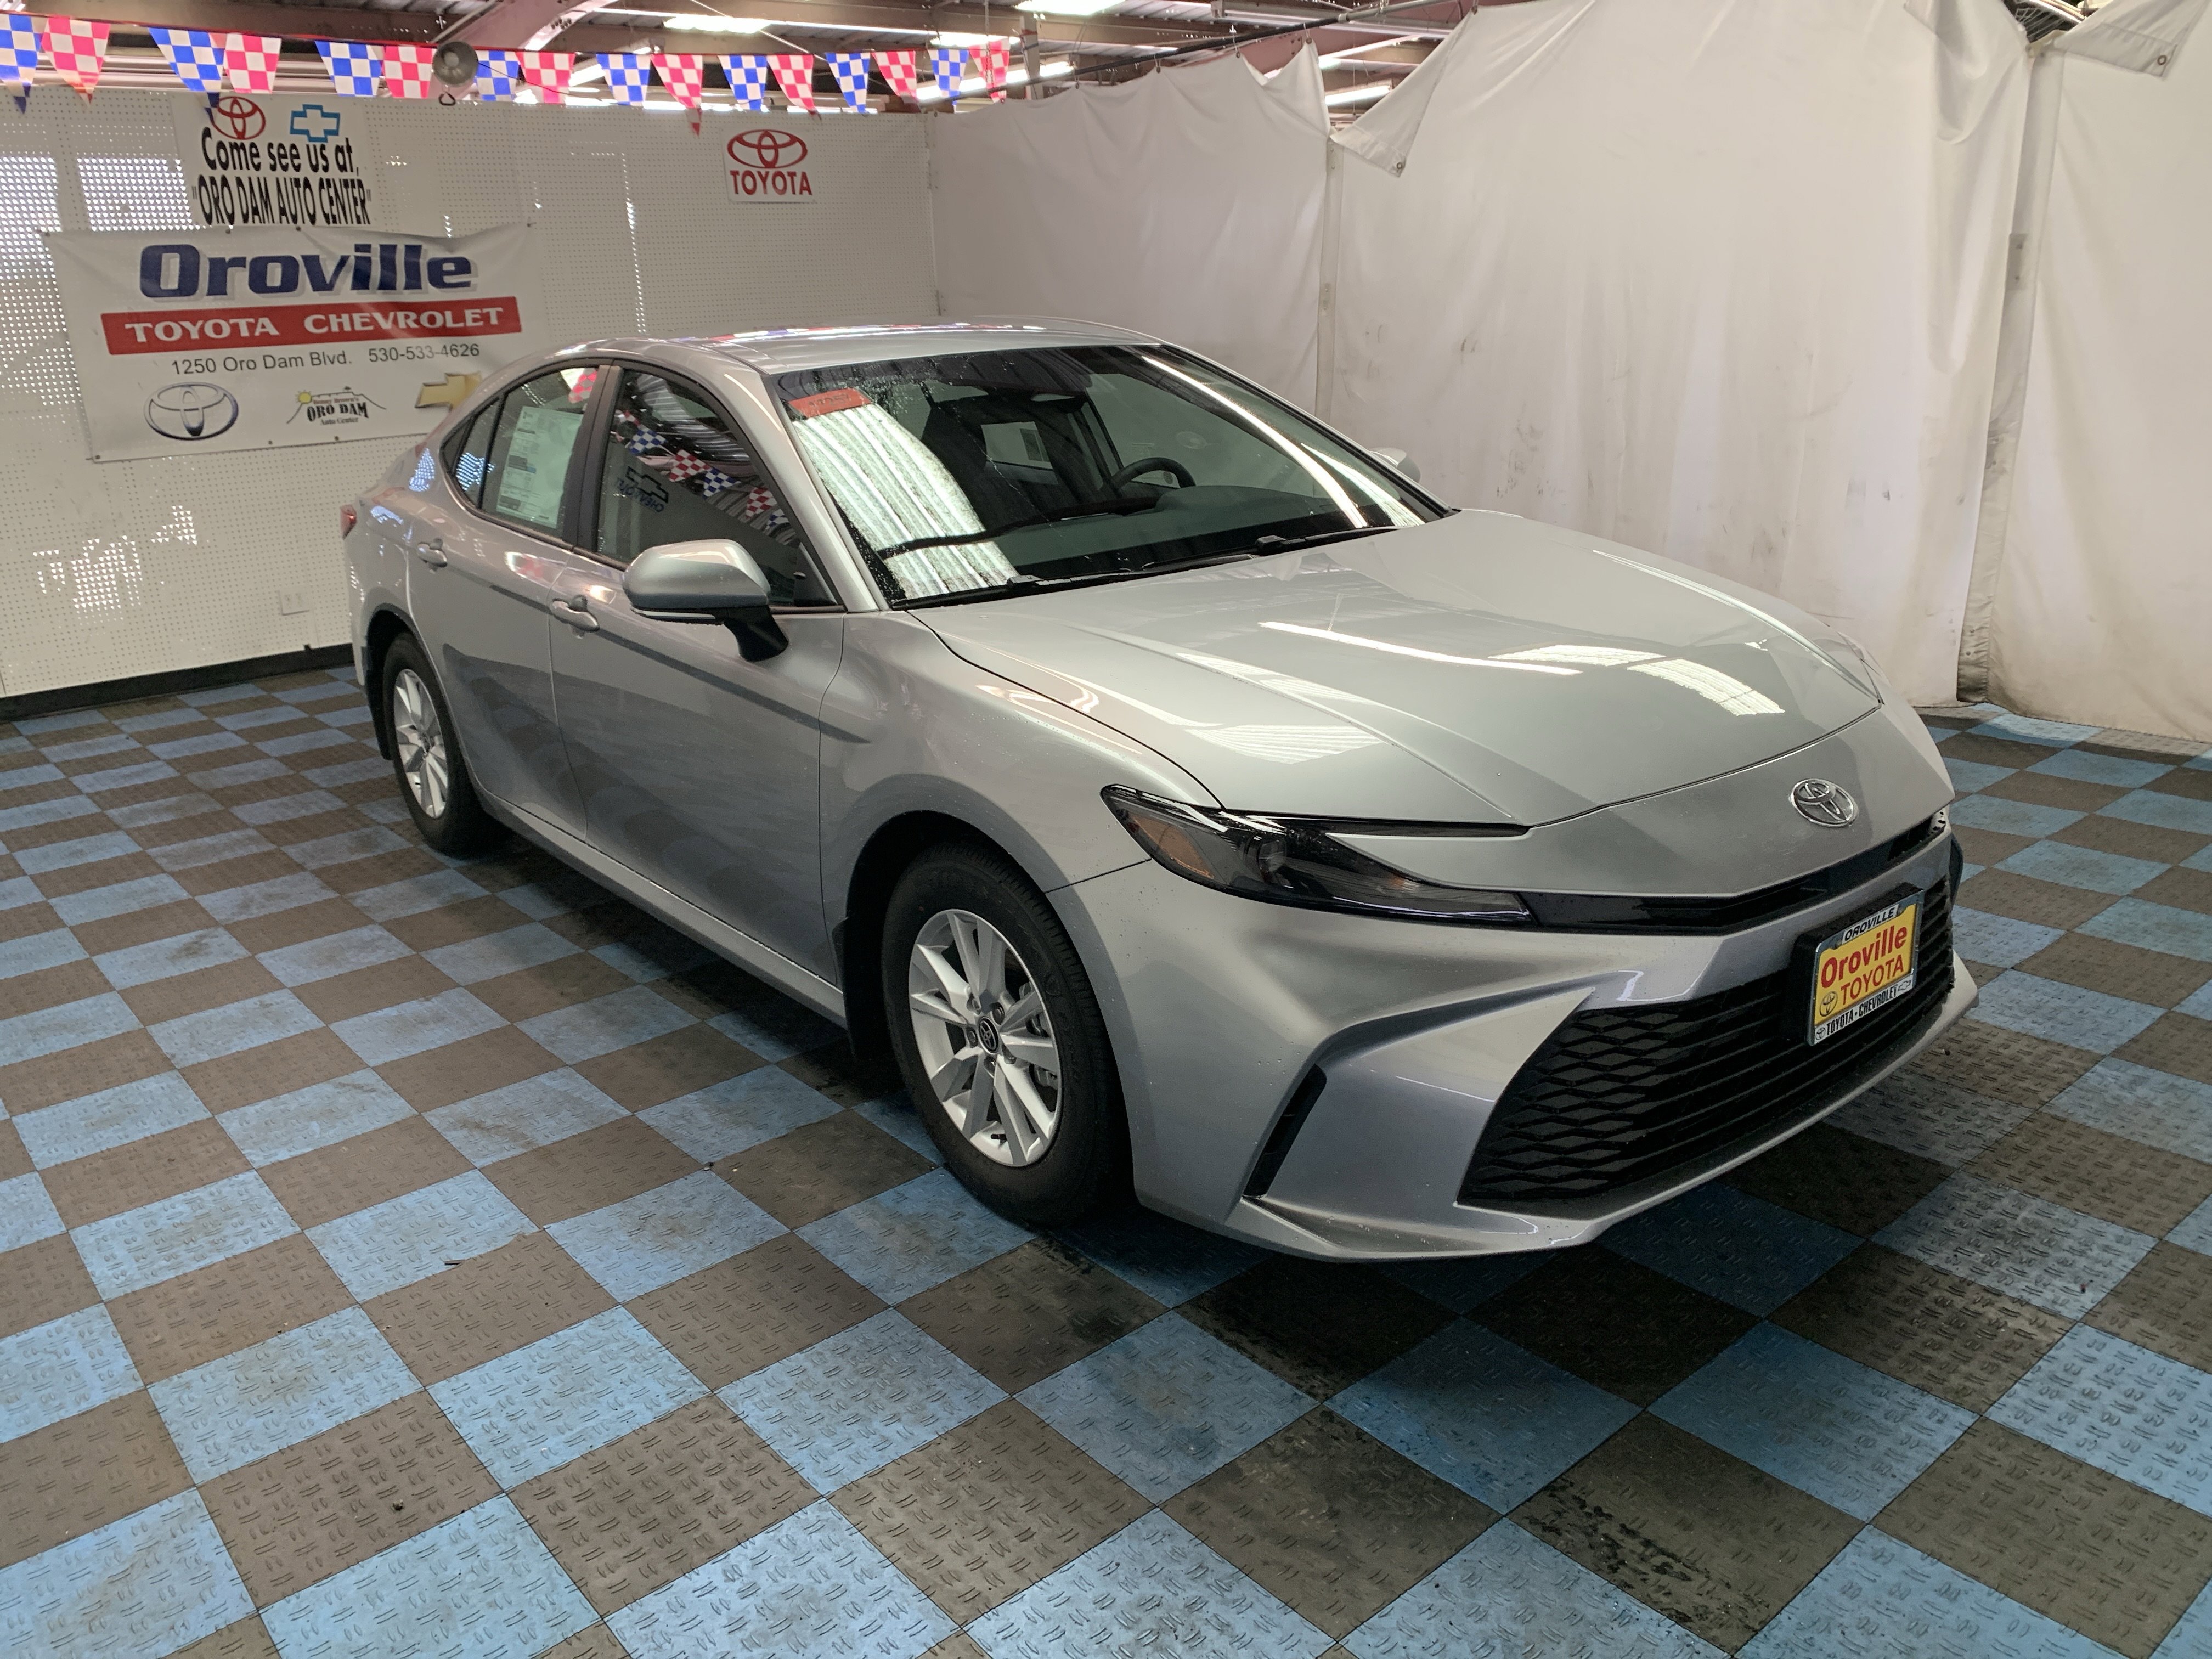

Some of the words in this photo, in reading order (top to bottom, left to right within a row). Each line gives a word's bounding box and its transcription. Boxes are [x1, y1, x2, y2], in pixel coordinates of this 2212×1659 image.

[201, 126, 261, 171] Come
[267, 142, 301, 172] see
[306, 144, 329, 173] us
[335, 137, 359, 176] at,
[235, 176, 275, 224] DAM
[275, 176, 317, 225] AUTO
[730, 170, 812, 195] TOYOTA
[139, 243, 472, 298] Oroville
[125, 317, 280, 343] TOYOTA
[303, 307, 503, 334] CHEVROLET
[172, 358, 217, 375] 1250
[223, 357, 257, 371] Oro
[262, 354, 304, 369] Dam
[309, 350, 352, 366] Blvd.
[369, 343, 480, 362] 530-533-4626
[307, 404, 335, 422] ORO
[338, 402, 369, 419] DAM
[1844, 907, 1895, 941] OROVILLE
[1821, 925, 1908, 989] Oroville
[1841, 954, 1904, 1005] TOYOTA
[1826, 1009, 1854, 1036] TOYOTA
[1859, 984, 1898, 1017] CHEVROLET
